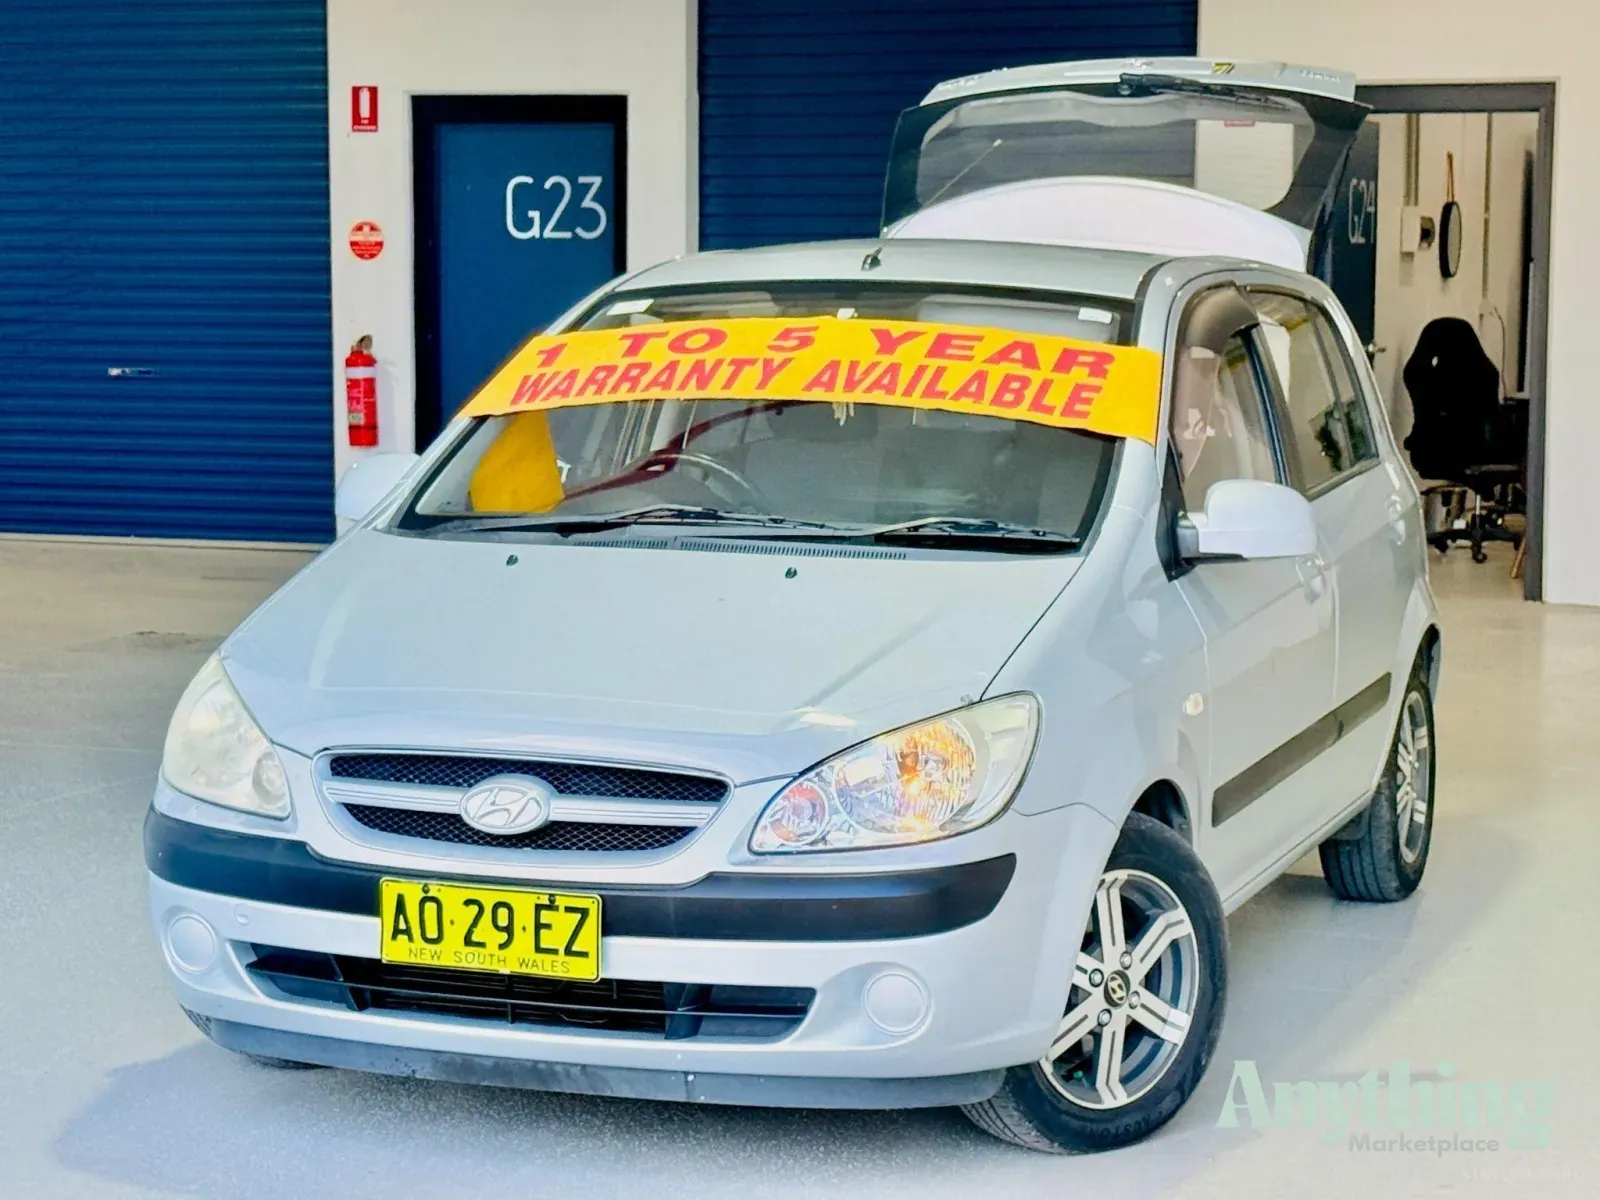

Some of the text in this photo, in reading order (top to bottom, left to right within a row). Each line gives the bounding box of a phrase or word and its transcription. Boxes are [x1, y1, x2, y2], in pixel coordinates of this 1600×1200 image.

[506, 175, 607, 239] G23
[1348, 178, 1376, 244] G24
[536, 326, 1116, 381] 1 TO 5 YEAR
[509, 357, 1103, 419] WARRANTY AVAILABLE
[408, 947, 571, 974] NEW SOUTH WALES
